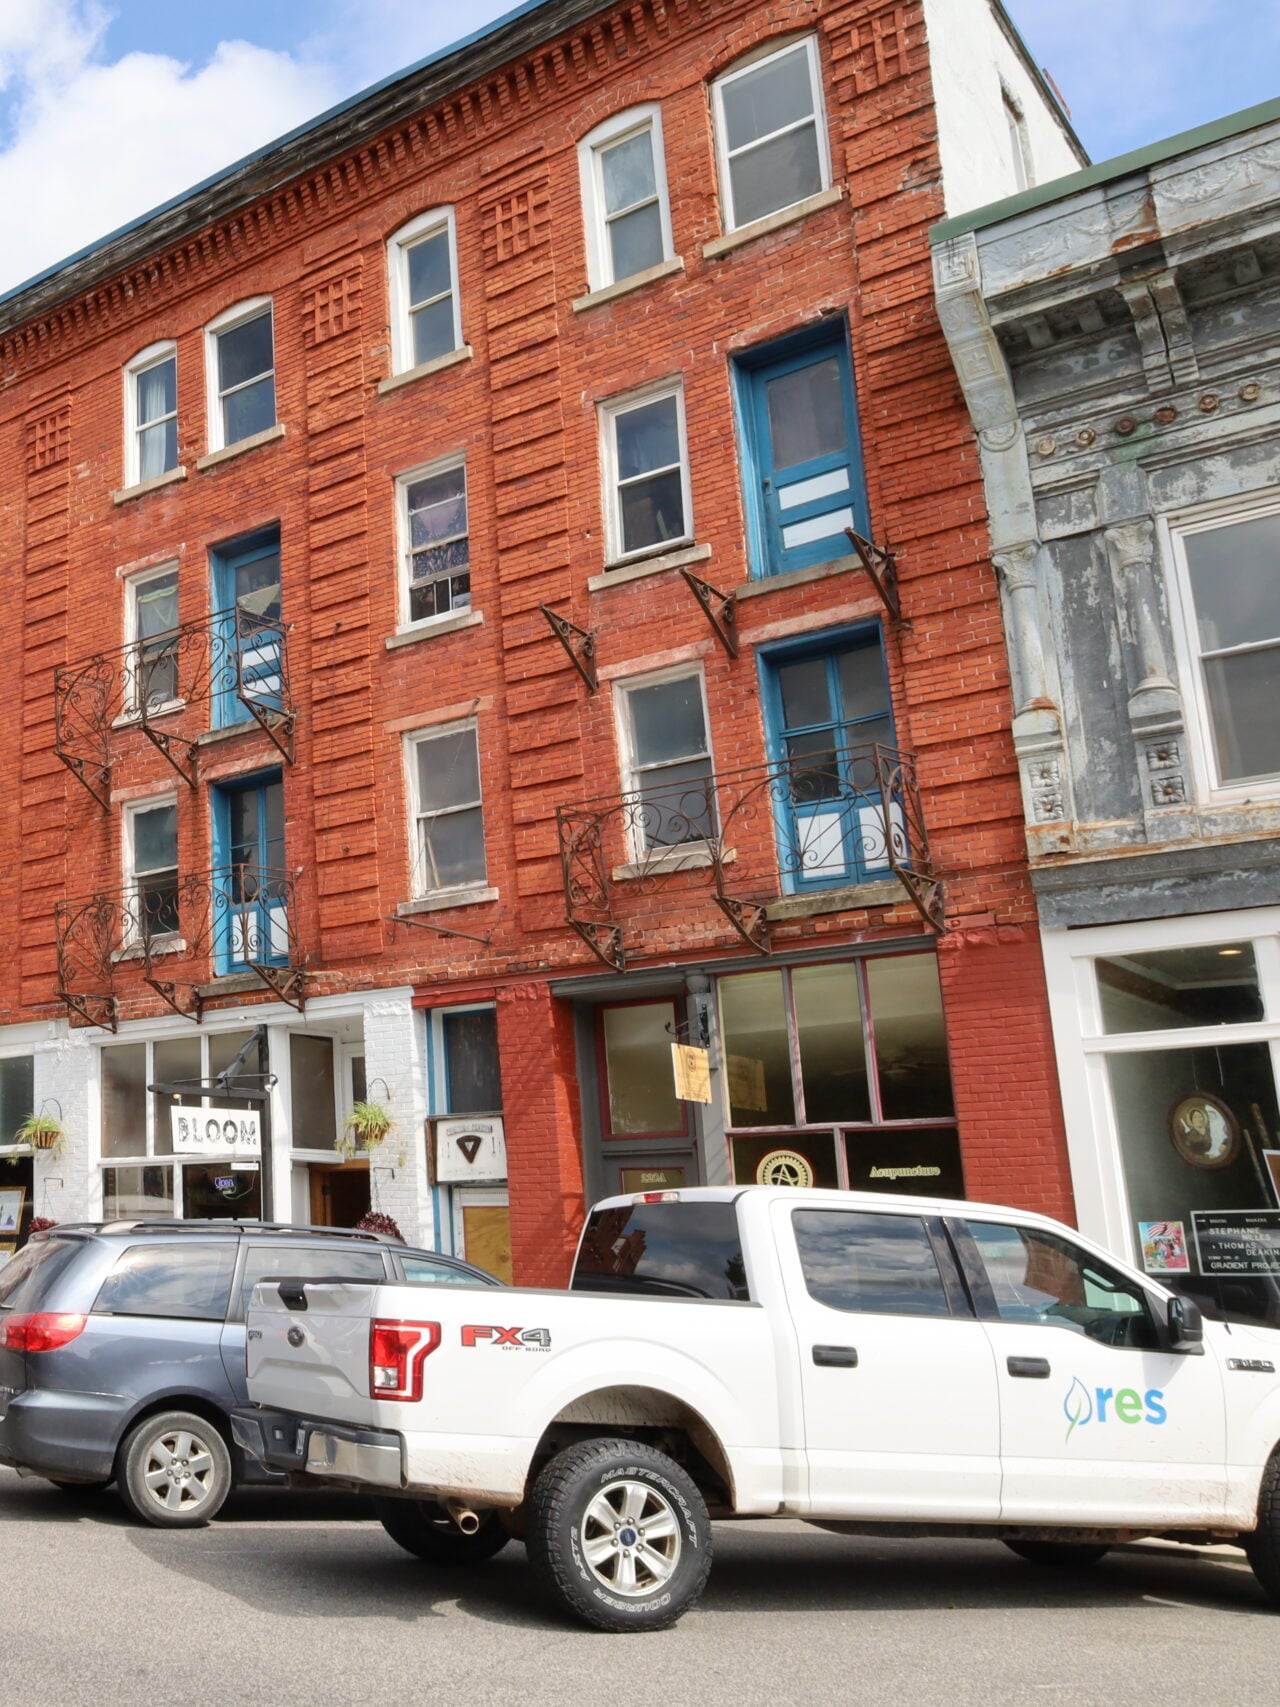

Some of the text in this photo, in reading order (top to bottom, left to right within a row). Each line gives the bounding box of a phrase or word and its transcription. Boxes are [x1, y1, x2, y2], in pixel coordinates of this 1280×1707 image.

[178, 1117, 256, 1145] BLOOM
[869, 1165, 941, 1180] Acupuncture
[1218, 1242, 1257, 1250] THOMAS
[1211, 1261, 1248, 1269] GRADIENT
[461, 1325, 551, 1347] FX4
[1096, 1387, 1167, 1425] res
[601, 1466, 697, 1548] MASTERCRAFT
[593, 1588, 671, 1612] COURSER
